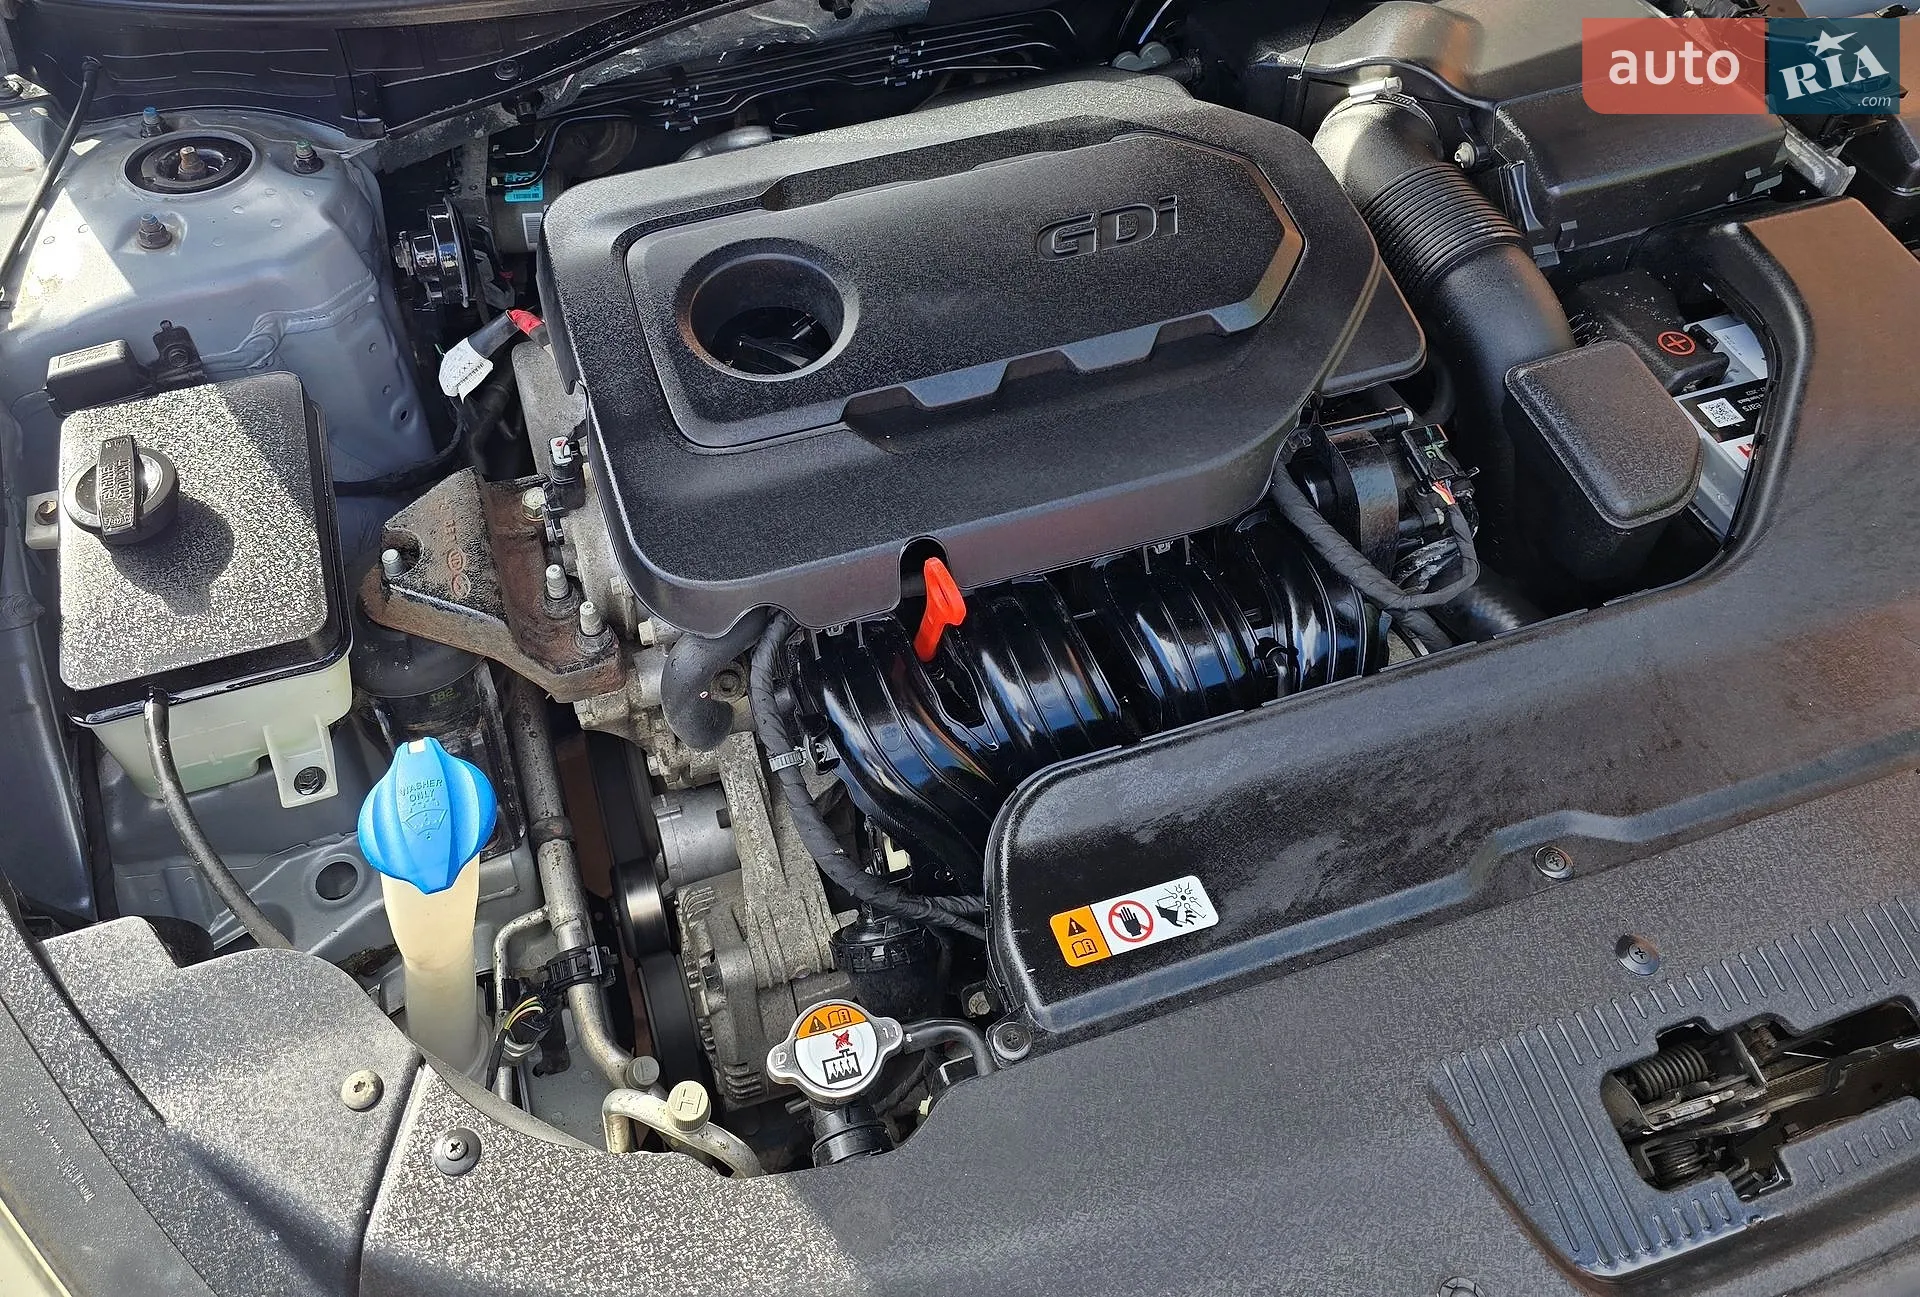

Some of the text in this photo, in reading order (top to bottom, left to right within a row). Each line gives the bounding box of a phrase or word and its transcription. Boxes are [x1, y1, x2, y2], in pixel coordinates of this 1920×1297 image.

[1036, 194, 1178, 262] GDi
[1742, 402, 1763, 412] ears
[400, 779, 443, 797] WASHER
[409, 789, 435, 802] ONLY
[676, 1087, 703, 1115] H
